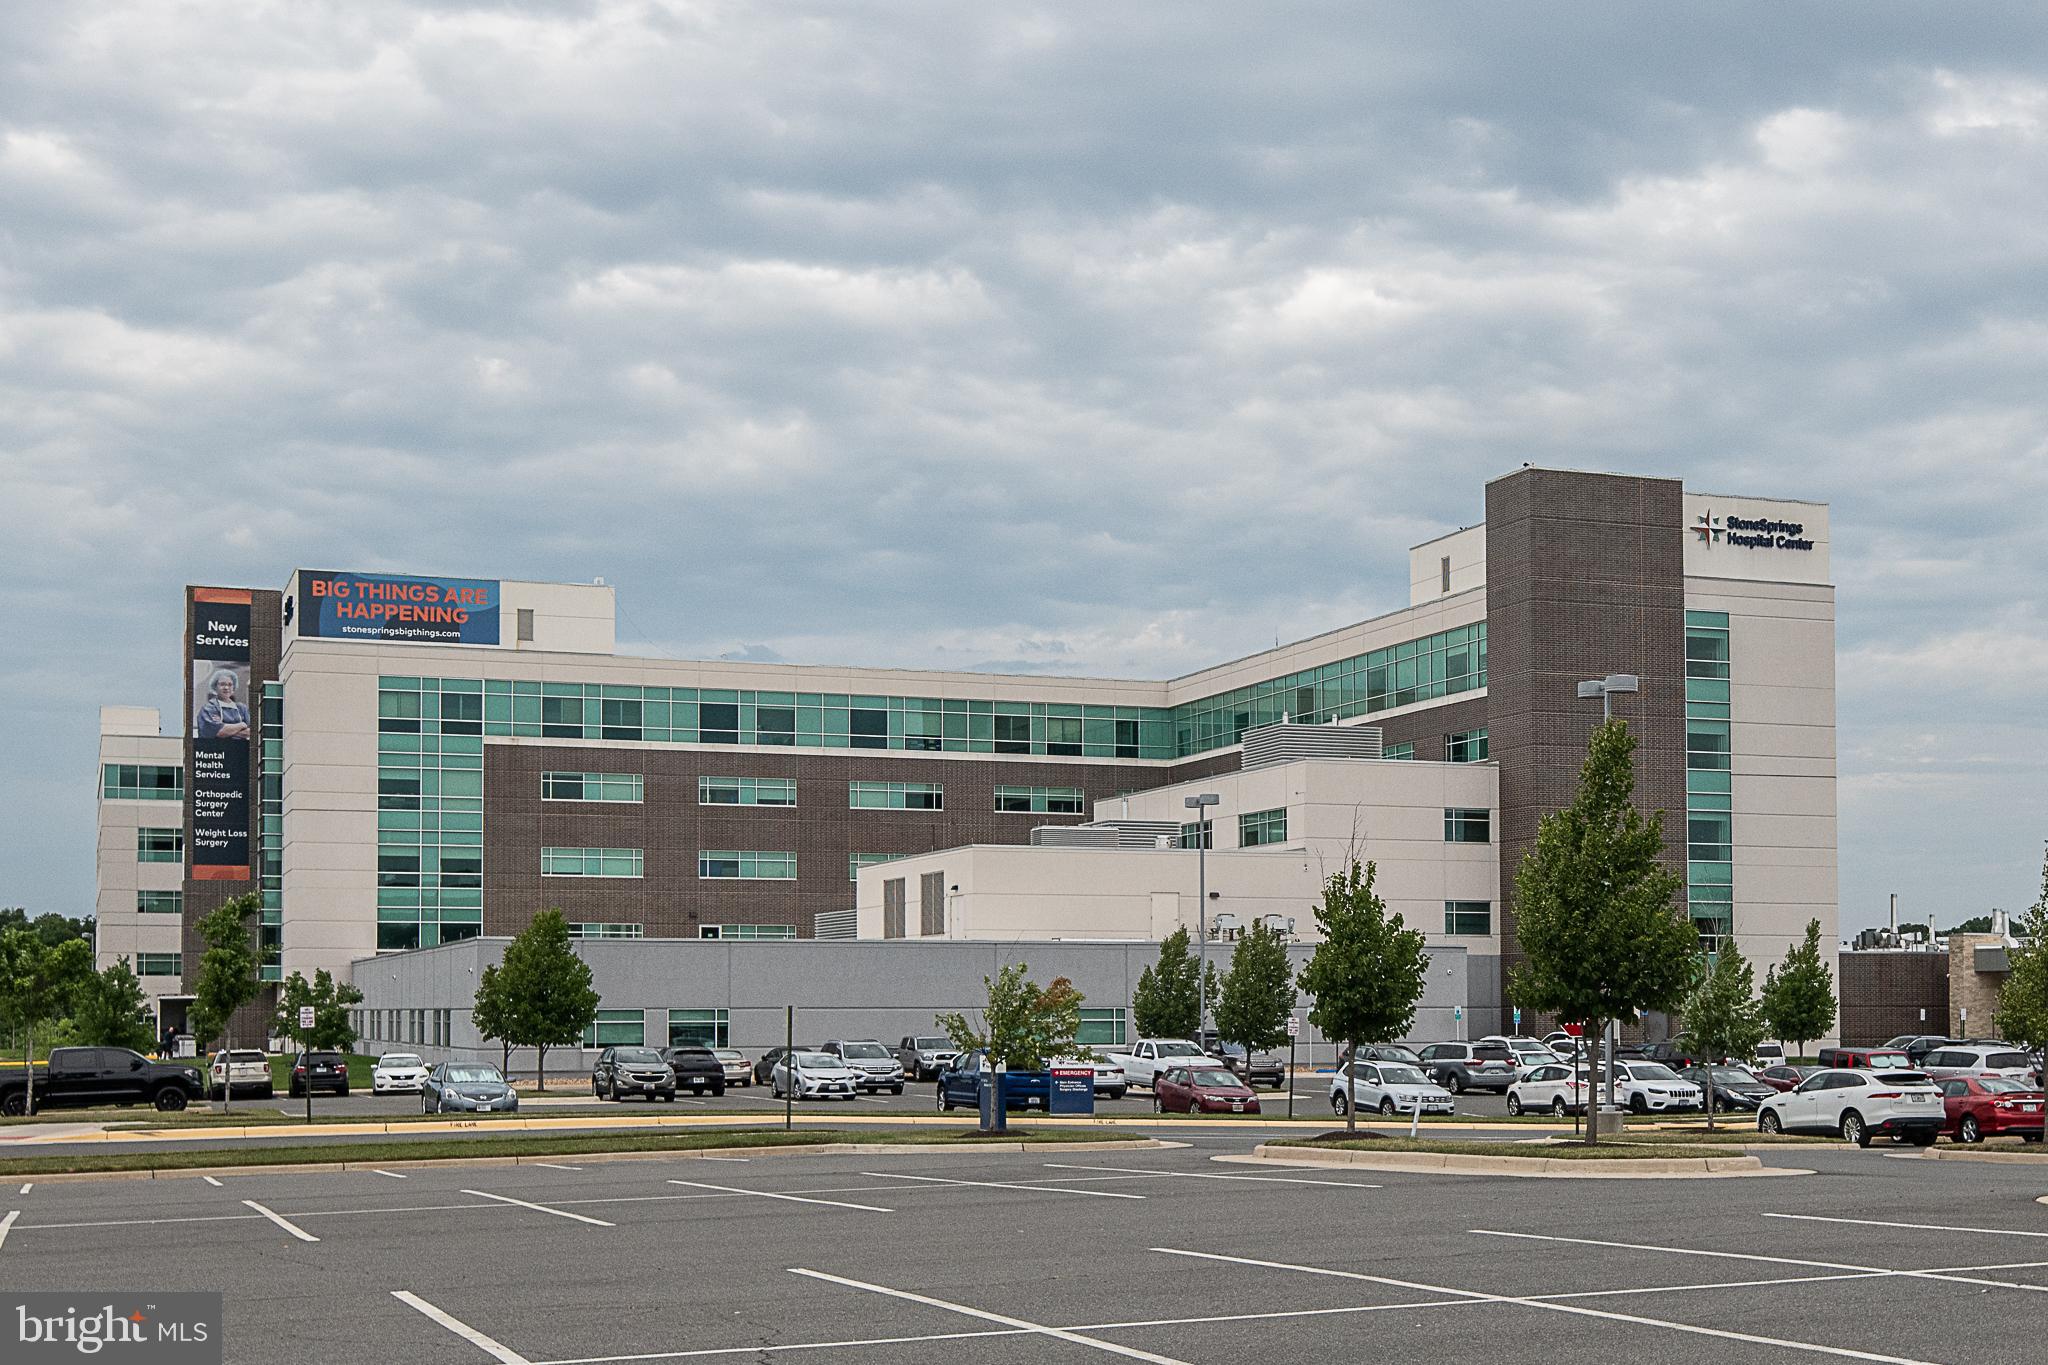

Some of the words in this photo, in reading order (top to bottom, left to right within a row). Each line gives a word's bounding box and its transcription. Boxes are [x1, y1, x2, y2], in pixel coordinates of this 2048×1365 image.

[1727, 515, 1804, 537] StoneSprings
[1727, 531, 1774, 549] Hospital
[1776, 535, 1814, 551] Center
[312, 580, 350, 598] BIG
[355, 582, 439, 602] THINGS
[444, 588, 488, 605] ARE
[336, 602, 469, 624] HAPPENING
[208, 620, 237, 632] New
[342, 625, 461, 638] stonespringsbigthings.com
[196, 634, 249, 647] Services
[195, 751, 225, 760] Mental
[195, 761, 224, 769] Health
[195, 770, 231, 779] Services
[195, 789, 243, 800] Orthopedic
[195, 800, 229, 809] Surgery
[195, 809, 225, 817] Center
[195, 828, 227, 839] Weight
[228, 829, 248, 837] Loss
[195, 838, 229, 848] Surgery
